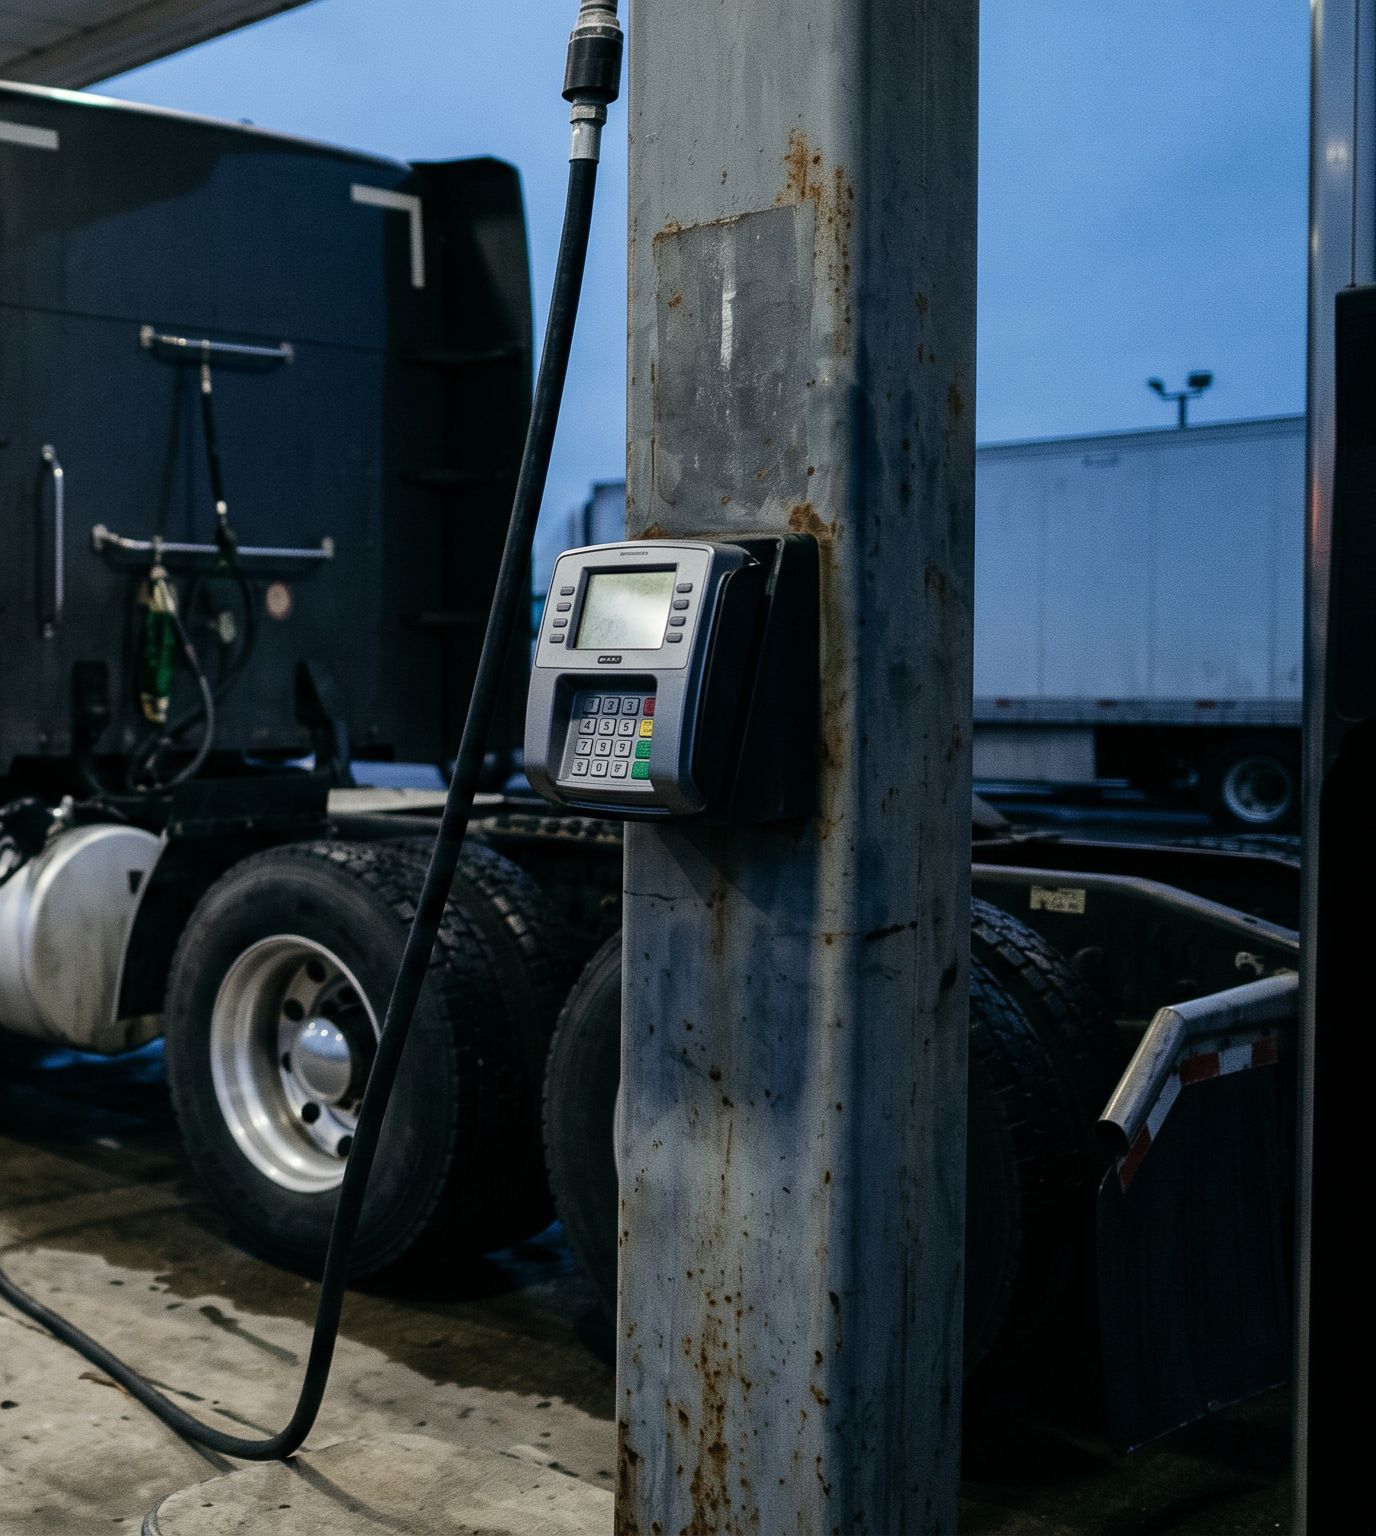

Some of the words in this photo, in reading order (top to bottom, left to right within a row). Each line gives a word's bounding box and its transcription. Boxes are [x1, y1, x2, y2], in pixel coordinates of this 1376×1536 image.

[584, 720, 591, 730] 4
[623, 722, 630, 732] 5
[581, 741, 588, 751] 7
[596, 762, 602, 772] 0
